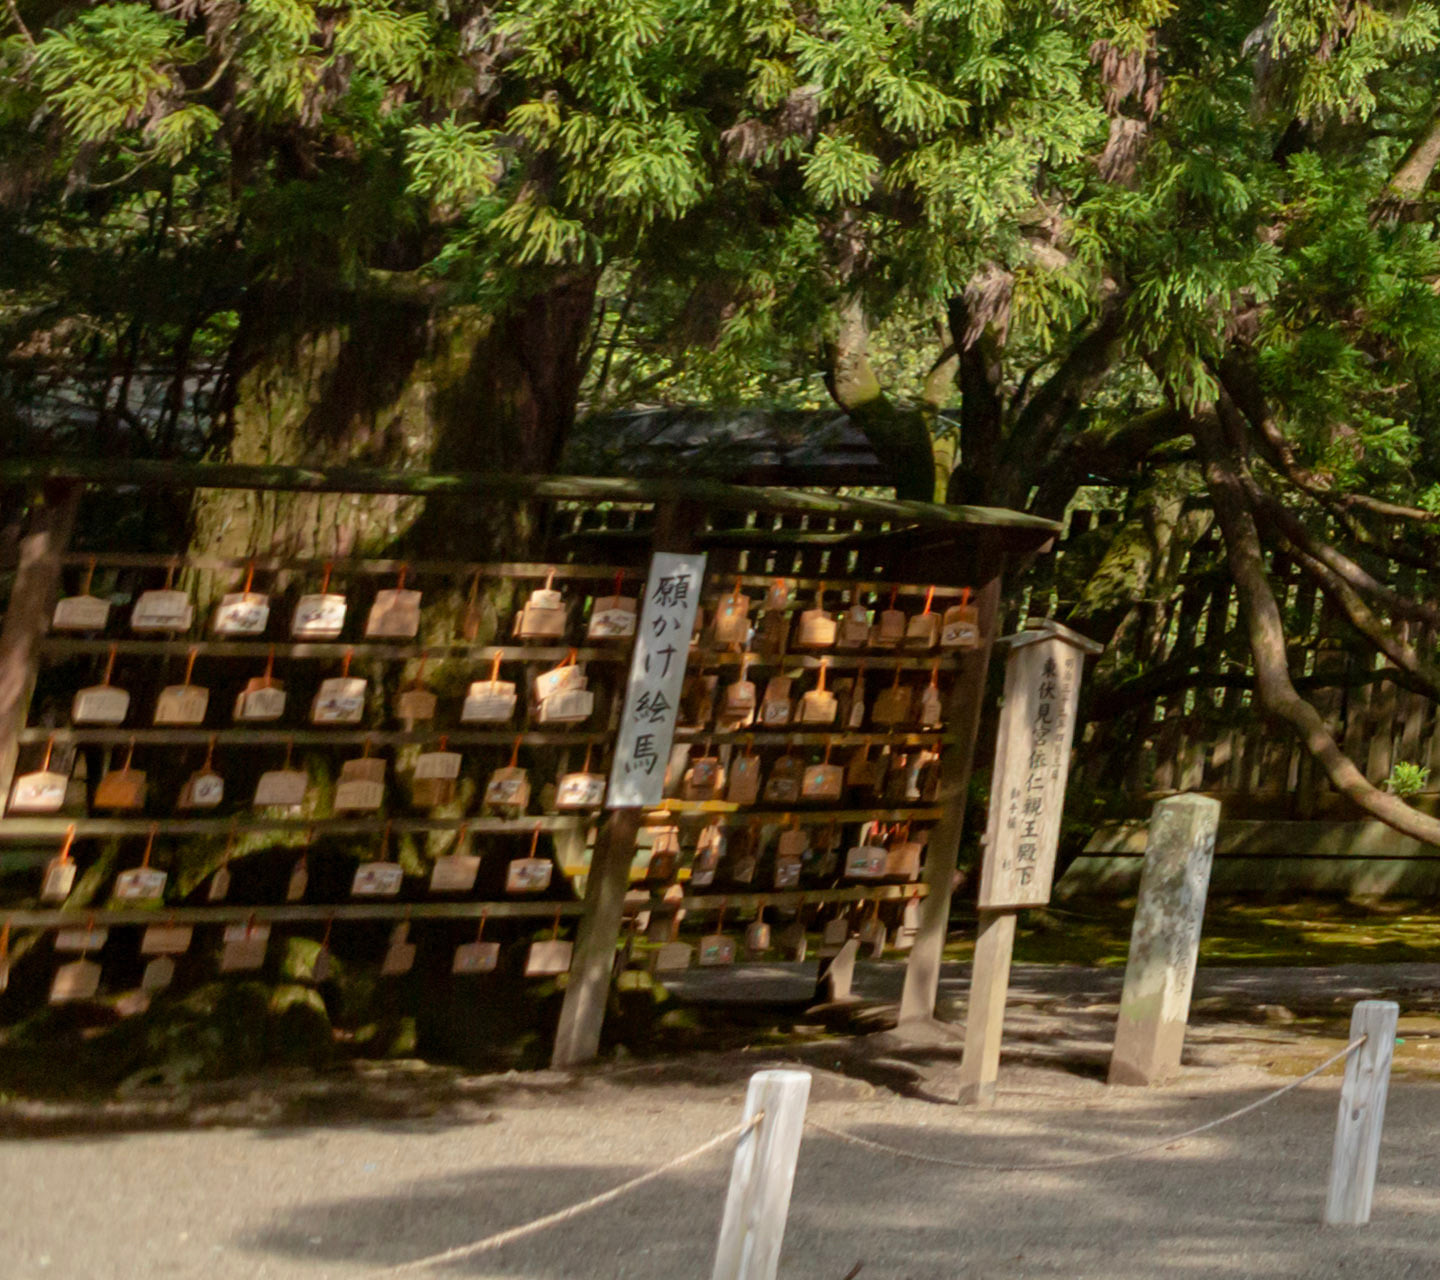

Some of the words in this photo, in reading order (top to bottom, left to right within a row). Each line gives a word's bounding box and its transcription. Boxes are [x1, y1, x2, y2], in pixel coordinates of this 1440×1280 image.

[624, 573, 692, 776] 願かけ絵馬
[1015, 655, 1058, 887] 東伏見宮依仁親王殿下
